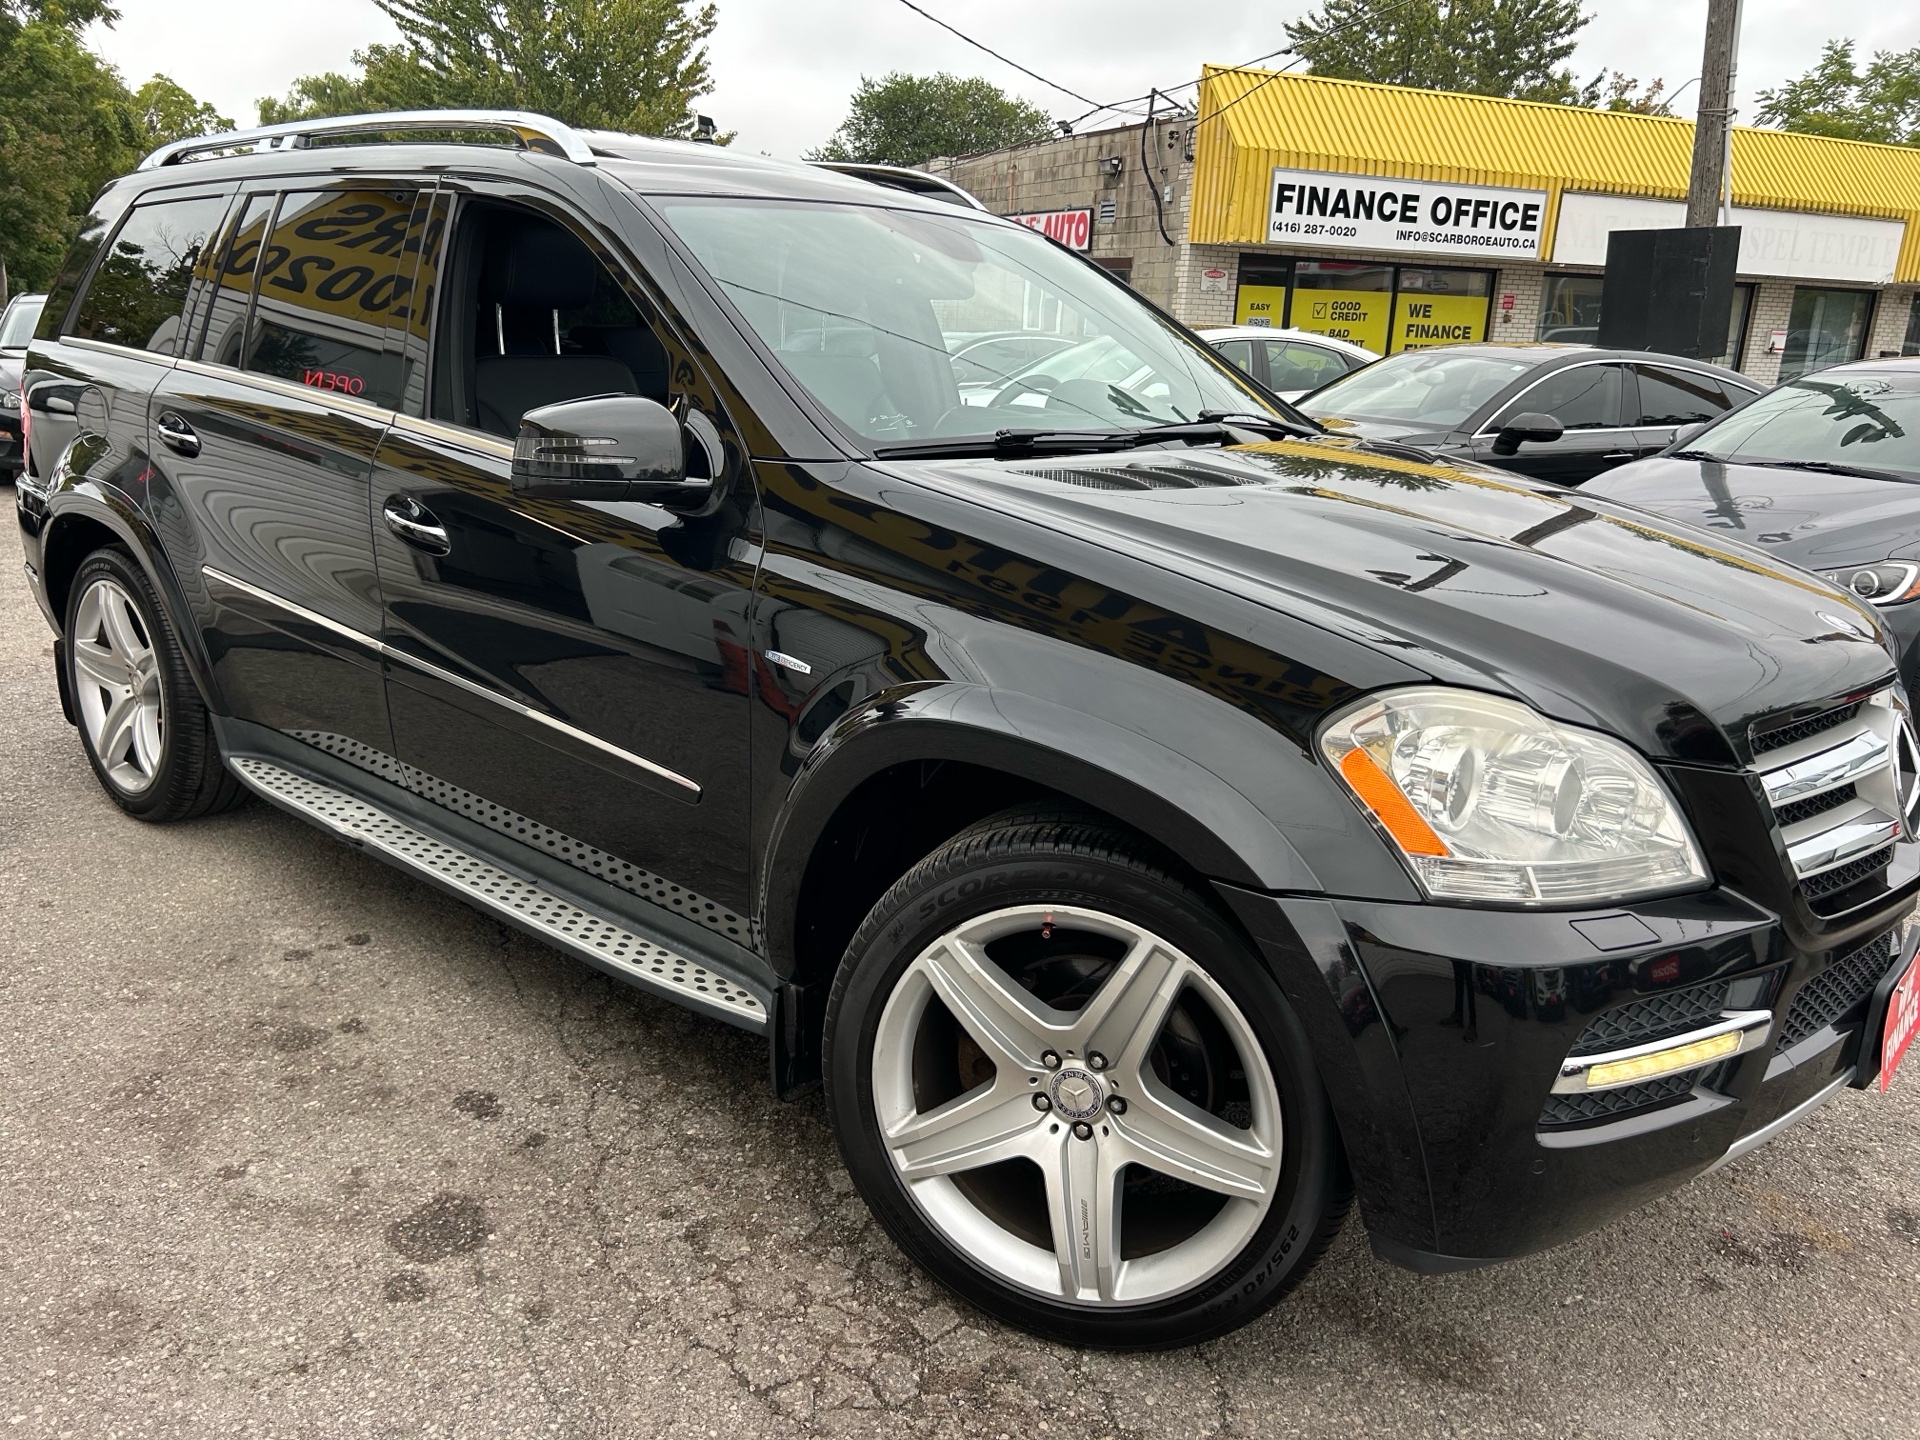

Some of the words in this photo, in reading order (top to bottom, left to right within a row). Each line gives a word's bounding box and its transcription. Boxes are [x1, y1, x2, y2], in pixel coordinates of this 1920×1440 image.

[1275, 183, 1420, 223] FINANCE
[1430, 196, 1540, 232] OFFICE
[1043, 212, 1089, 248] AUTO
[1272, 221, 1300, 233] (416)
[1304, 224, 1357, 237] 287-0020
[1396, 230, 1536, 249] INFO@SCARBOROEAUTO.CA
[1809, 231, 1897, 269] TEMPLE
[1250, 303, 1271, 311] EASY
[1331, 301, 1361, 311] GOOD
[1409, 304, 1432, 318] WE
[1330, 311, 1368, 322] CREDIT
[1328, 329, 1350, 338] BAD
[1406, 324, 1472, 340] FINANCE
[1241, 1223, 1300, 1296] 295/40
